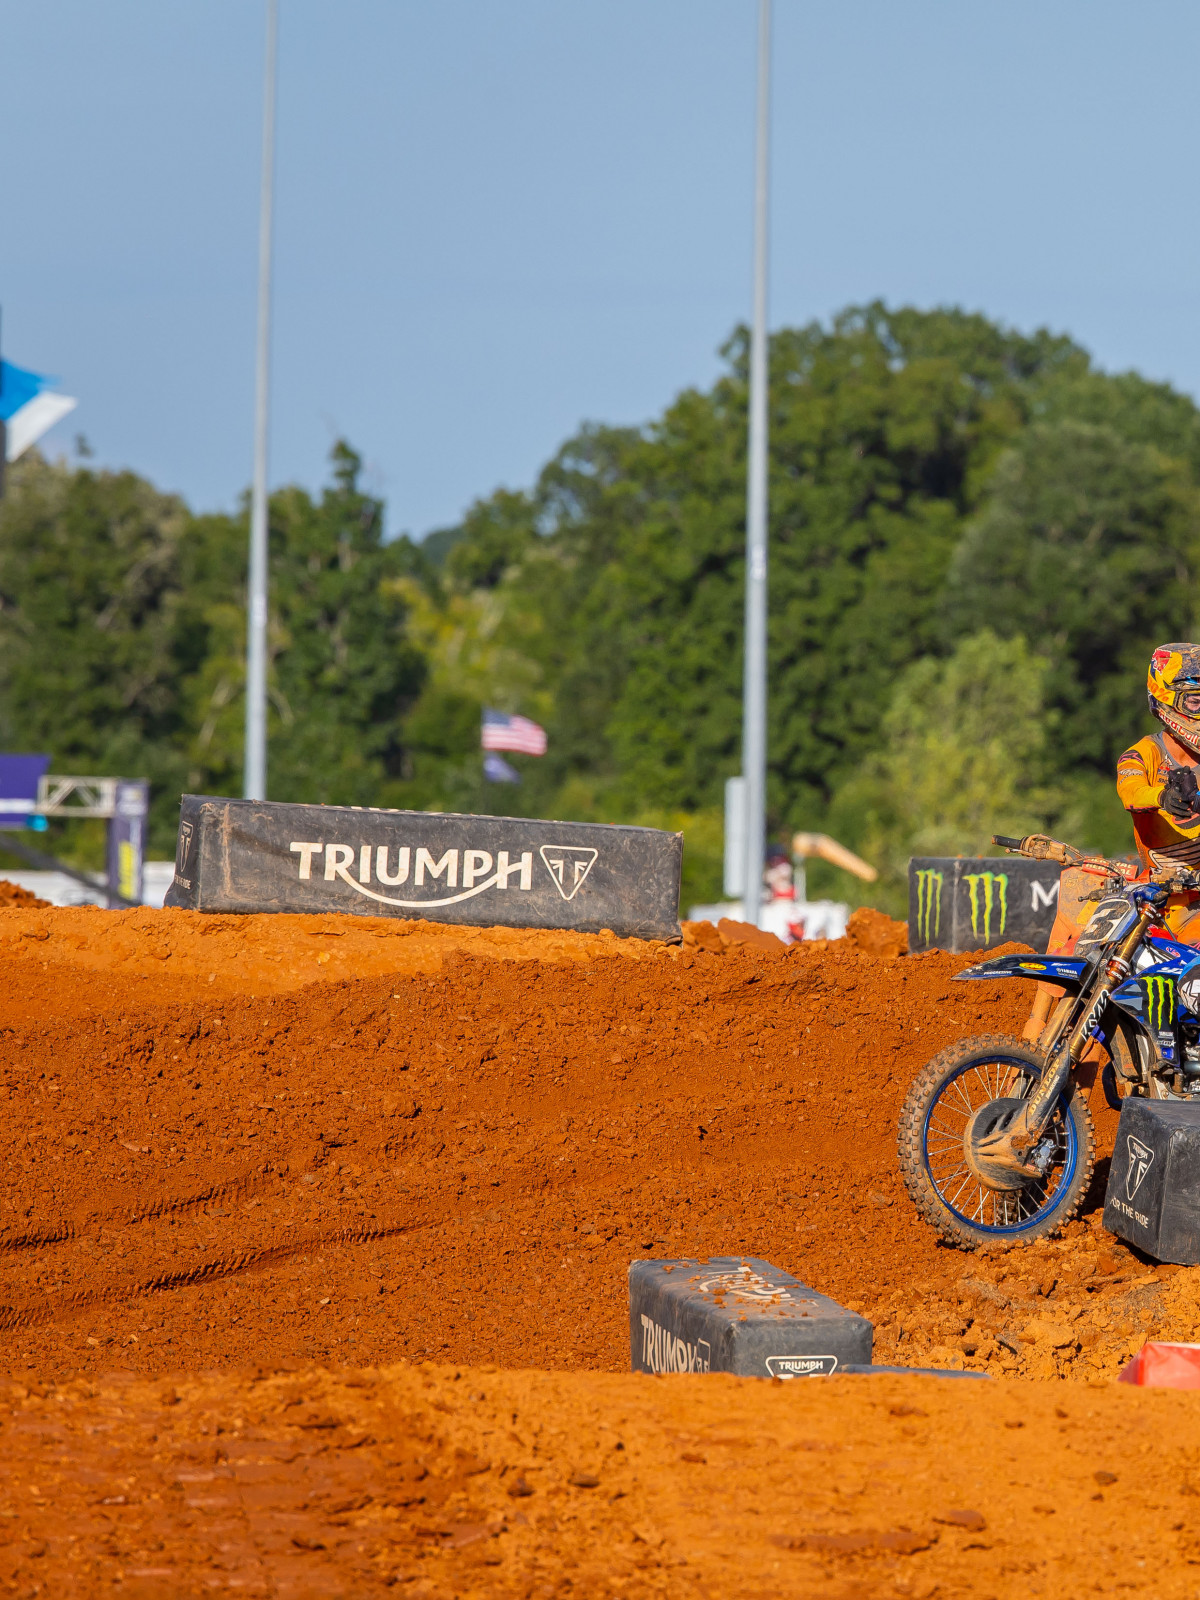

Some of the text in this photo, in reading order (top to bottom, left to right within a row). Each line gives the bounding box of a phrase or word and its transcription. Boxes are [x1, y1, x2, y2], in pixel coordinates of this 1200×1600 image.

[290, 842, 533, 908] TRIUMPH
[1029, 1058, 1060, 1116] DUNLOP
[1121, 1202, 1134, 1219] THE
[1134, 1210, 1149, 1229] RIDE
[641, 1313, 698, 1374] TRIUMPH
[779, 1361, 824, 1374] TRIUMPH
